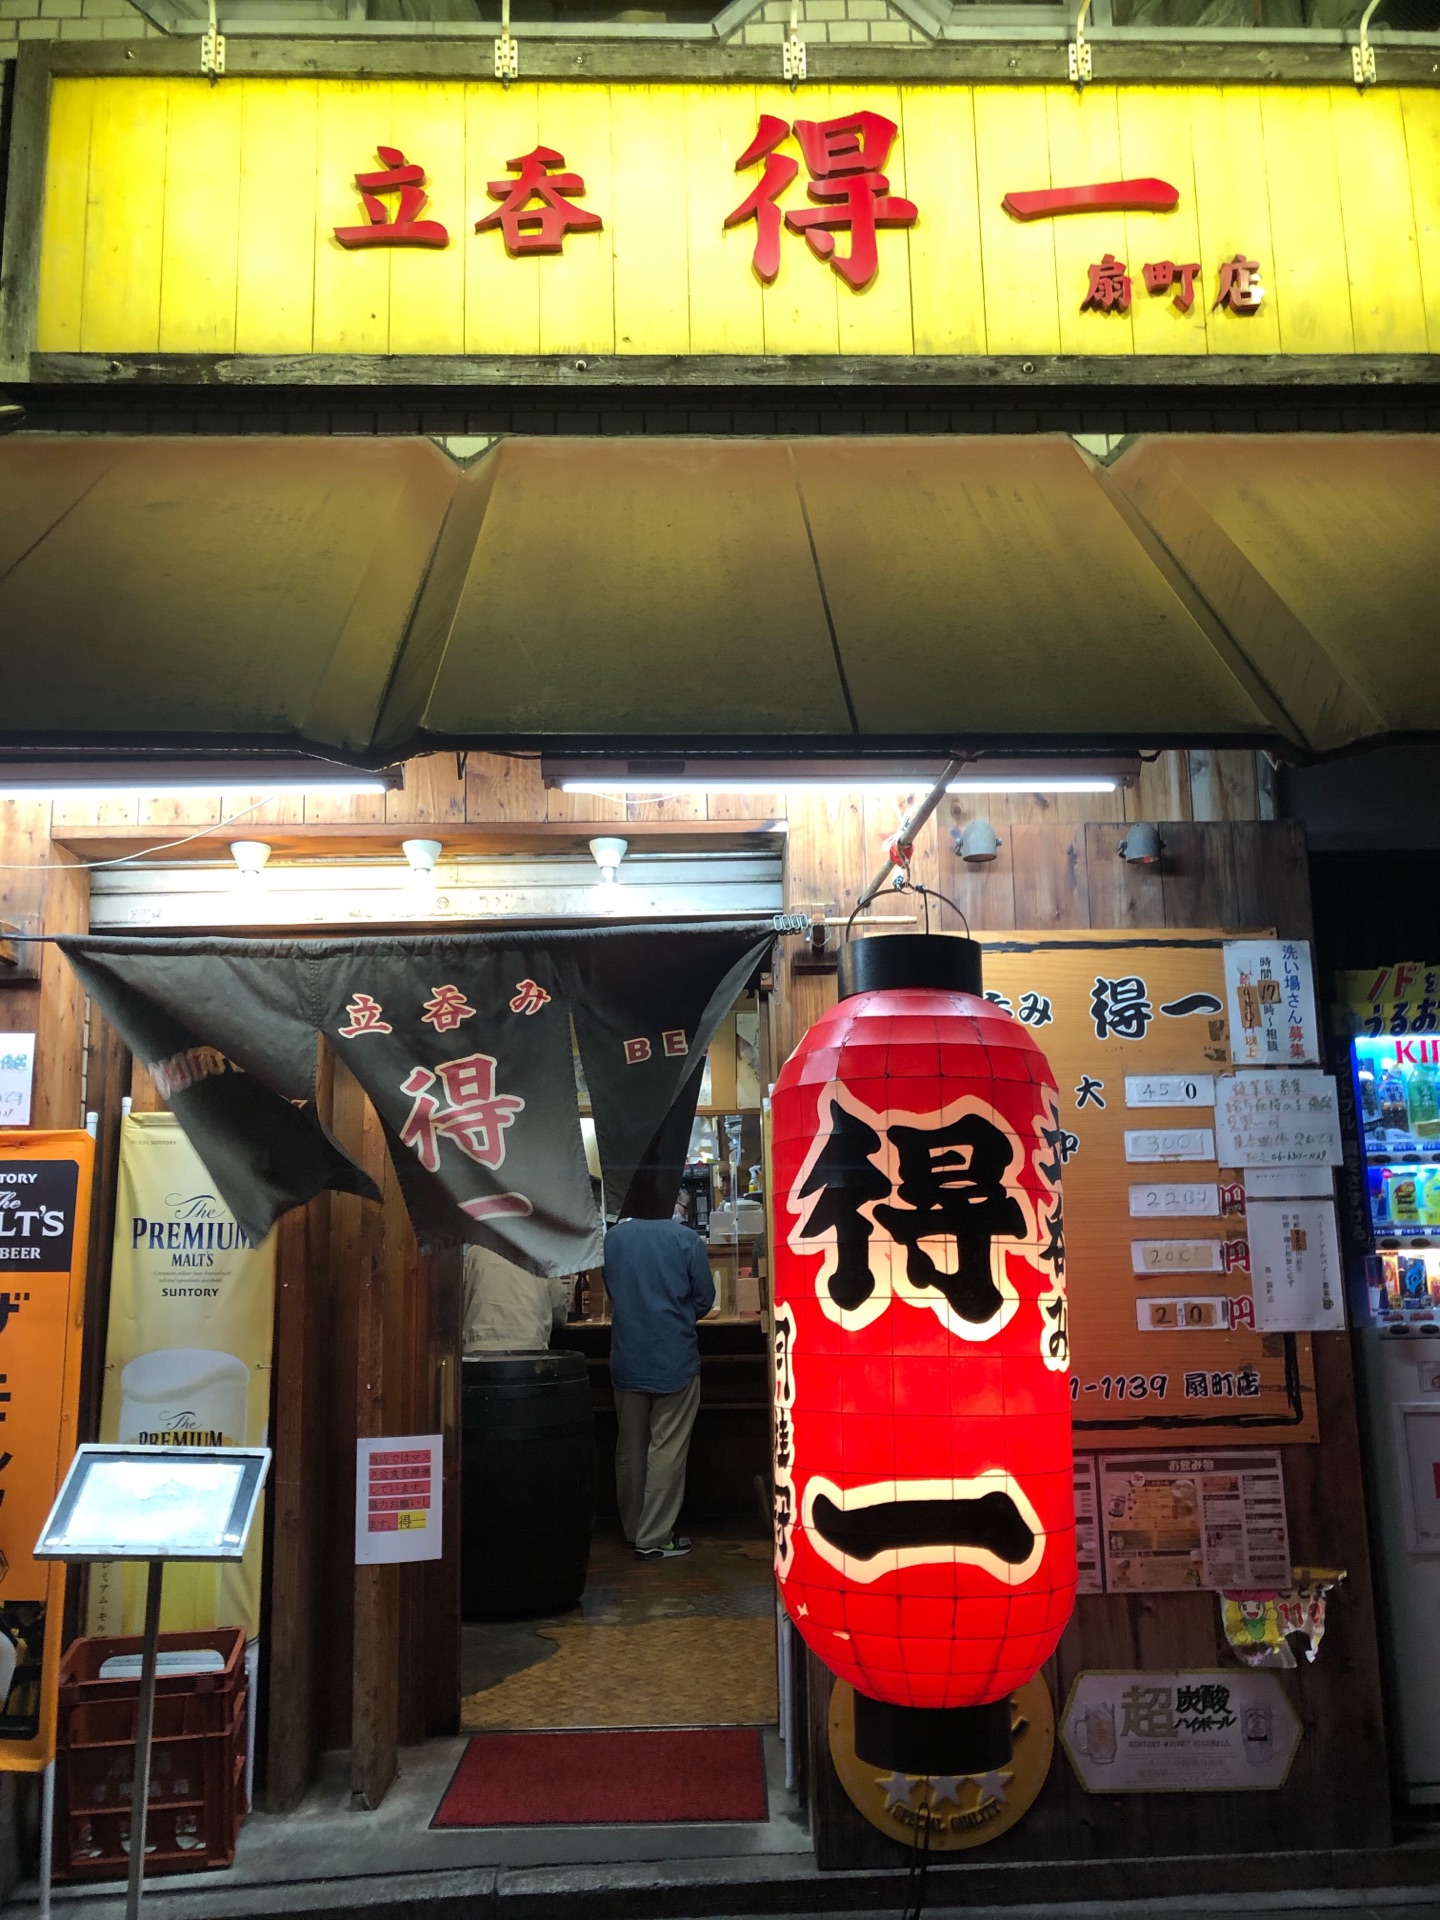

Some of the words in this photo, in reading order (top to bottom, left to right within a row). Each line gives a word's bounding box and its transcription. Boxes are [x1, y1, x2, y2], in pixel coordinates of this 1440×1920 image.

[1081, 253, 1266, 316] 扇町店
[338, 978, 552, 1039] 立呑み
[1090, 976, 1224, 1041] 得一
[1282, 943, 1306, 1059] 洗い場さん募集
[622, 1029, 690, 1066] BE
[1074, 1073, 1107, 1110] 大
[165, 1193, 226, 1220] The
[1220, 1183, 1246, 1217] 円
[171, 1250, 214, 1267] MALT'S
[1224, 1239, 1252, 1274] 円
[161, 1288, 220, 1297] SUNTORY
[1229, 1295, 1256, 1331] 円
[1184, 1371, 1262, 1398] 扇町店
[159, 1410, 203, 1431] The
[1120, 1684, 1179, 1738] 超
[1175, 1683, 1235, 1715] 炭酸
[1173, 1715, 1238, 1735] ハイボール
